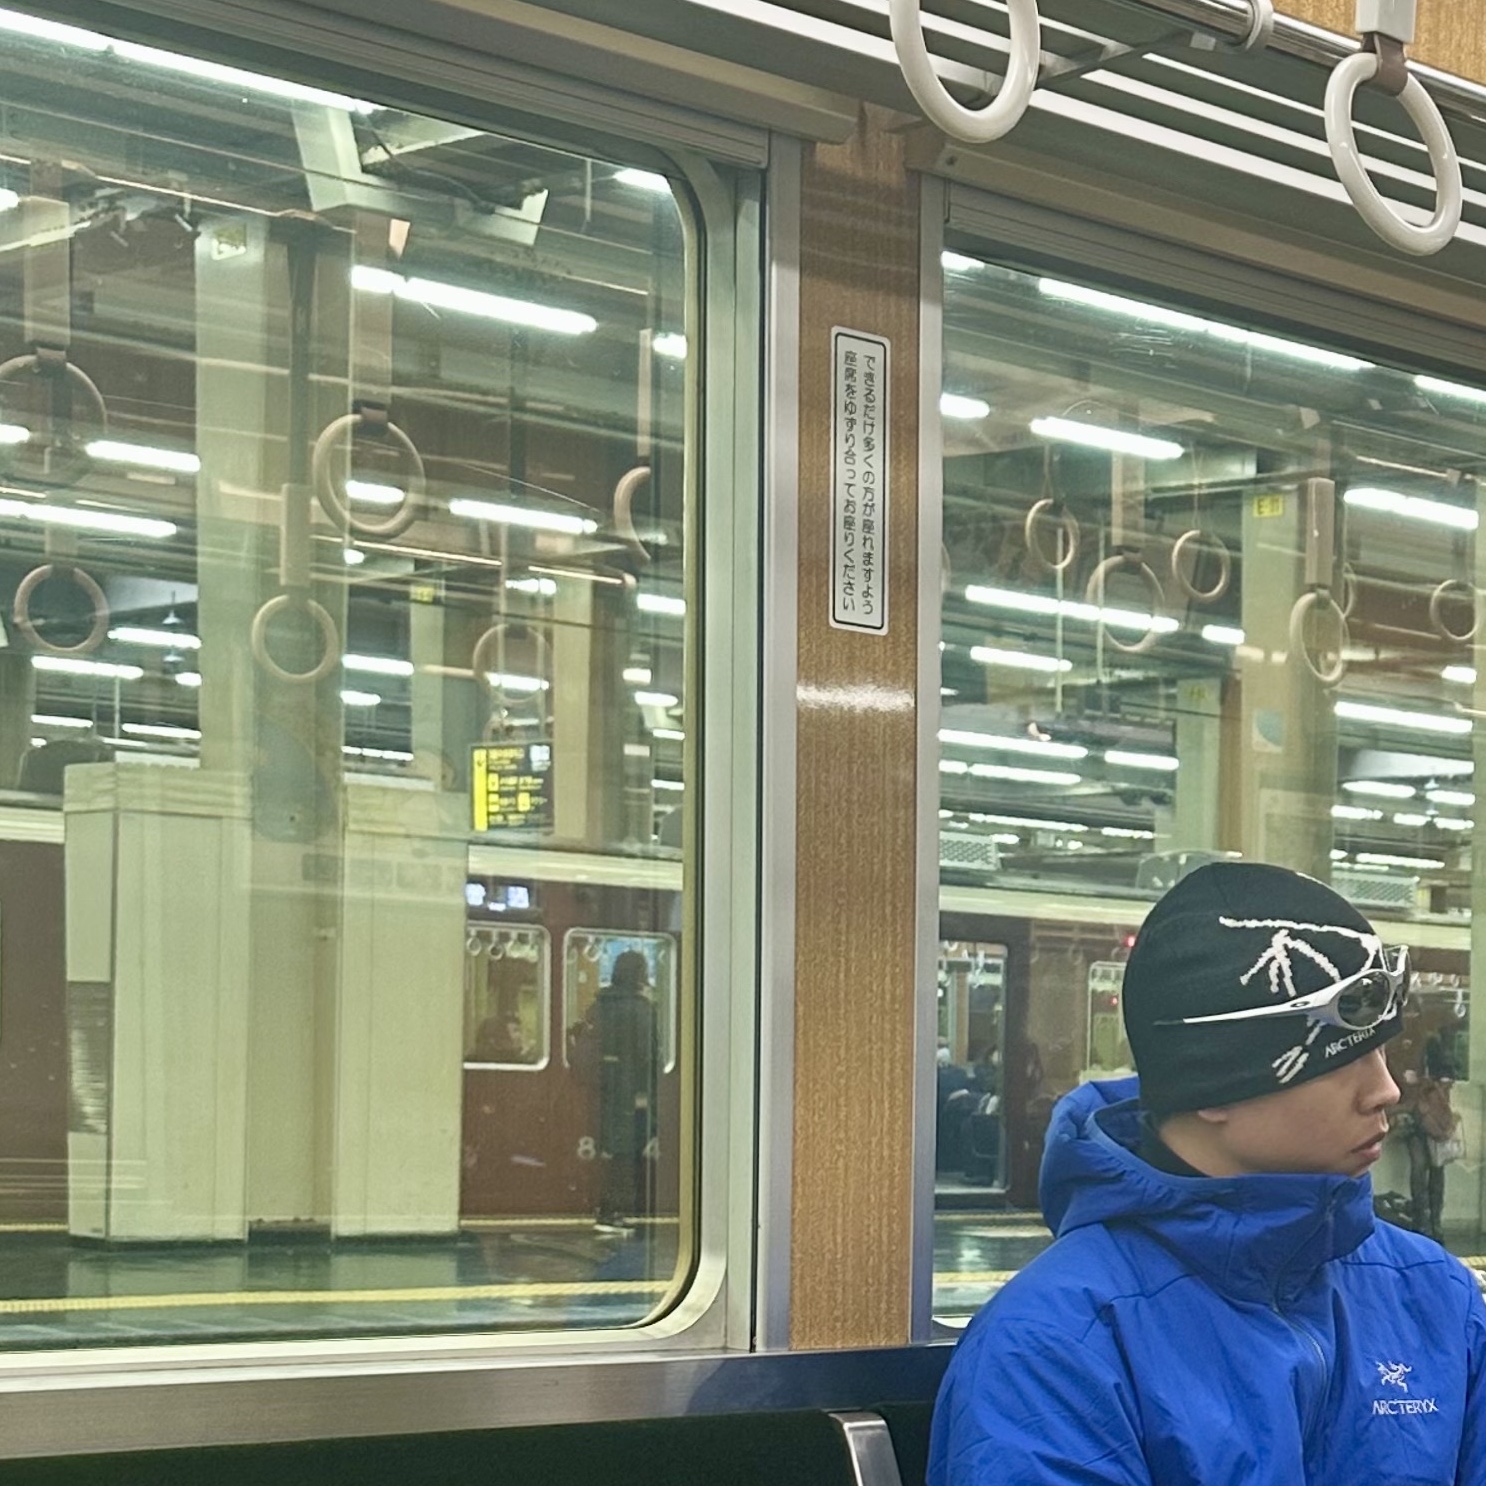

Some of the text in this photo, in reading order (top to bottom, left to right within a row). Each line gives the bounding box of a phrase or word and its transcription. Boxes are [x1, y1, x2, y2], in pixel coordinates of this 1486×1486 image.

[842, 350, 858, 611] 座席をゆずり合ってお座りください
[861, 354, 877, 615] できるだけ多くの方が座れますよう
